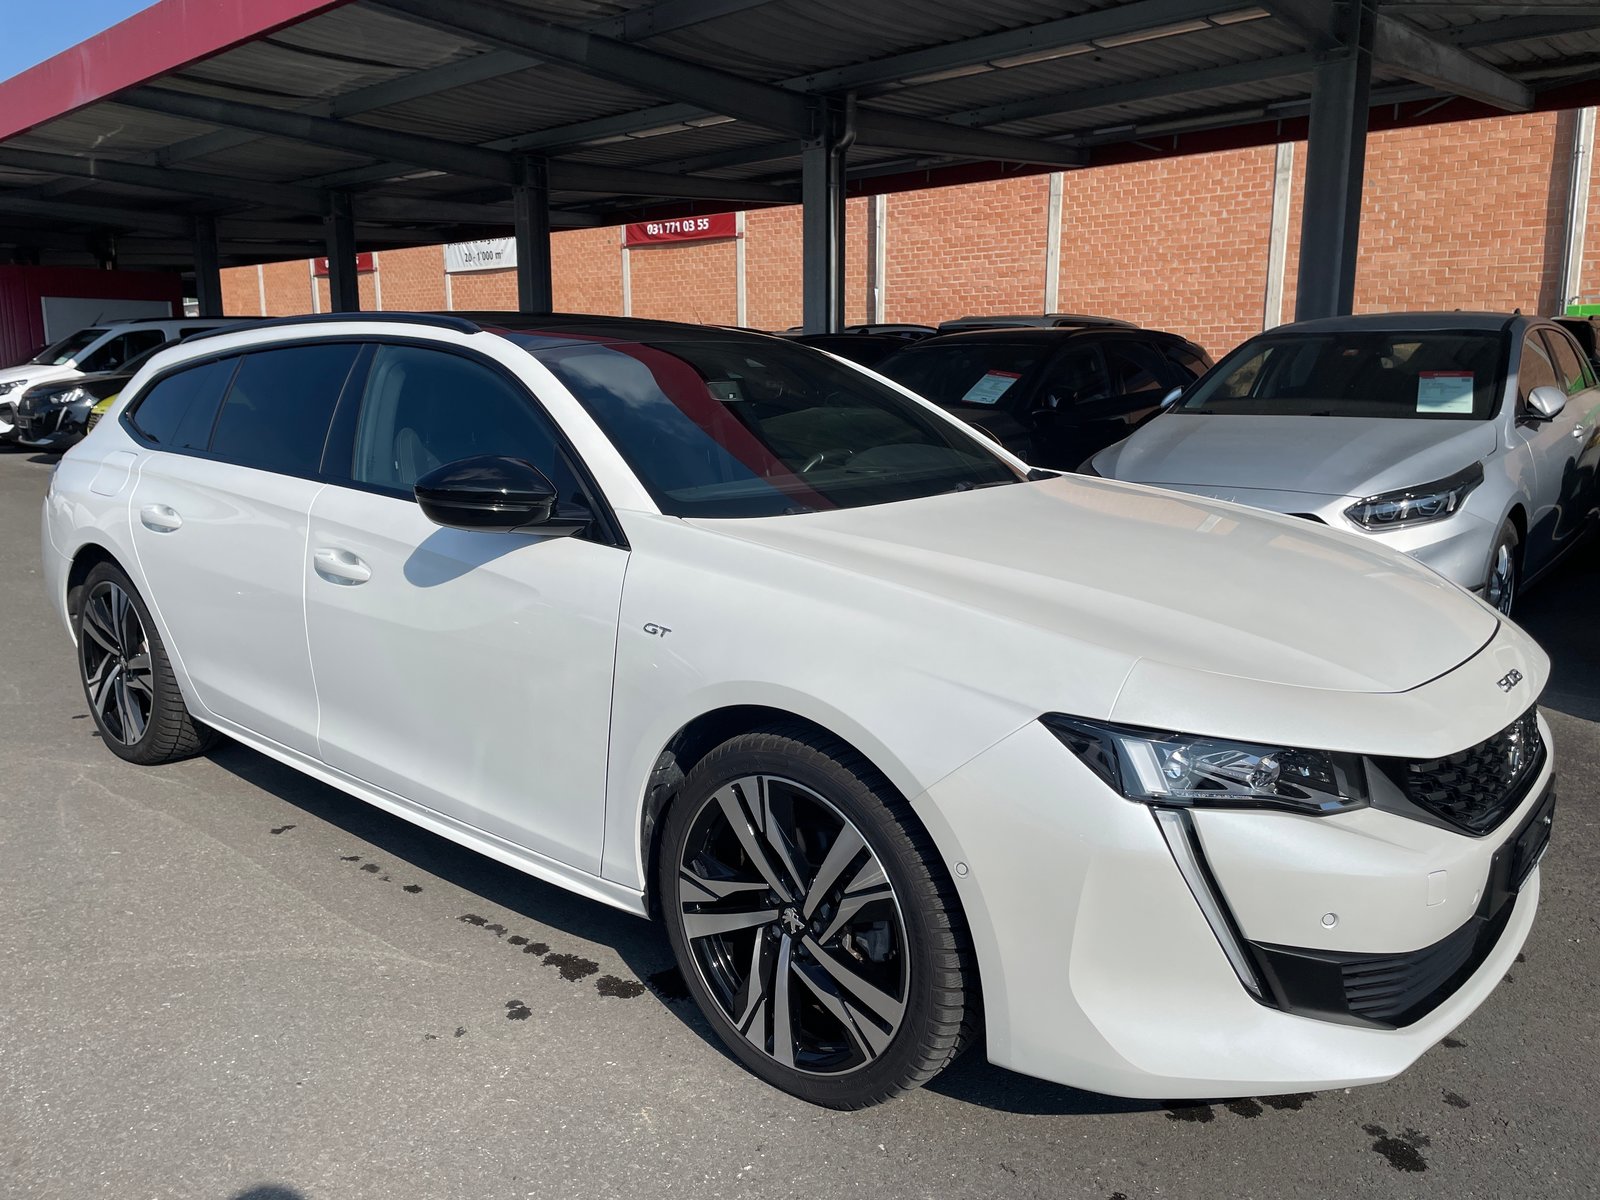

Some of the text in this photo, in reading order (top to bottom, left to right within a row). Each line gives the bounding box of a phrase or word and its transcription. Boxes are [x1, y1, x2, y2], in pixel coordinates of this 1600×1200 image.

[647, 218, 709, 235] 031 771 03 55
[643, 622, 672, 638] GT
[1496, 668, 1523, 693] 508
